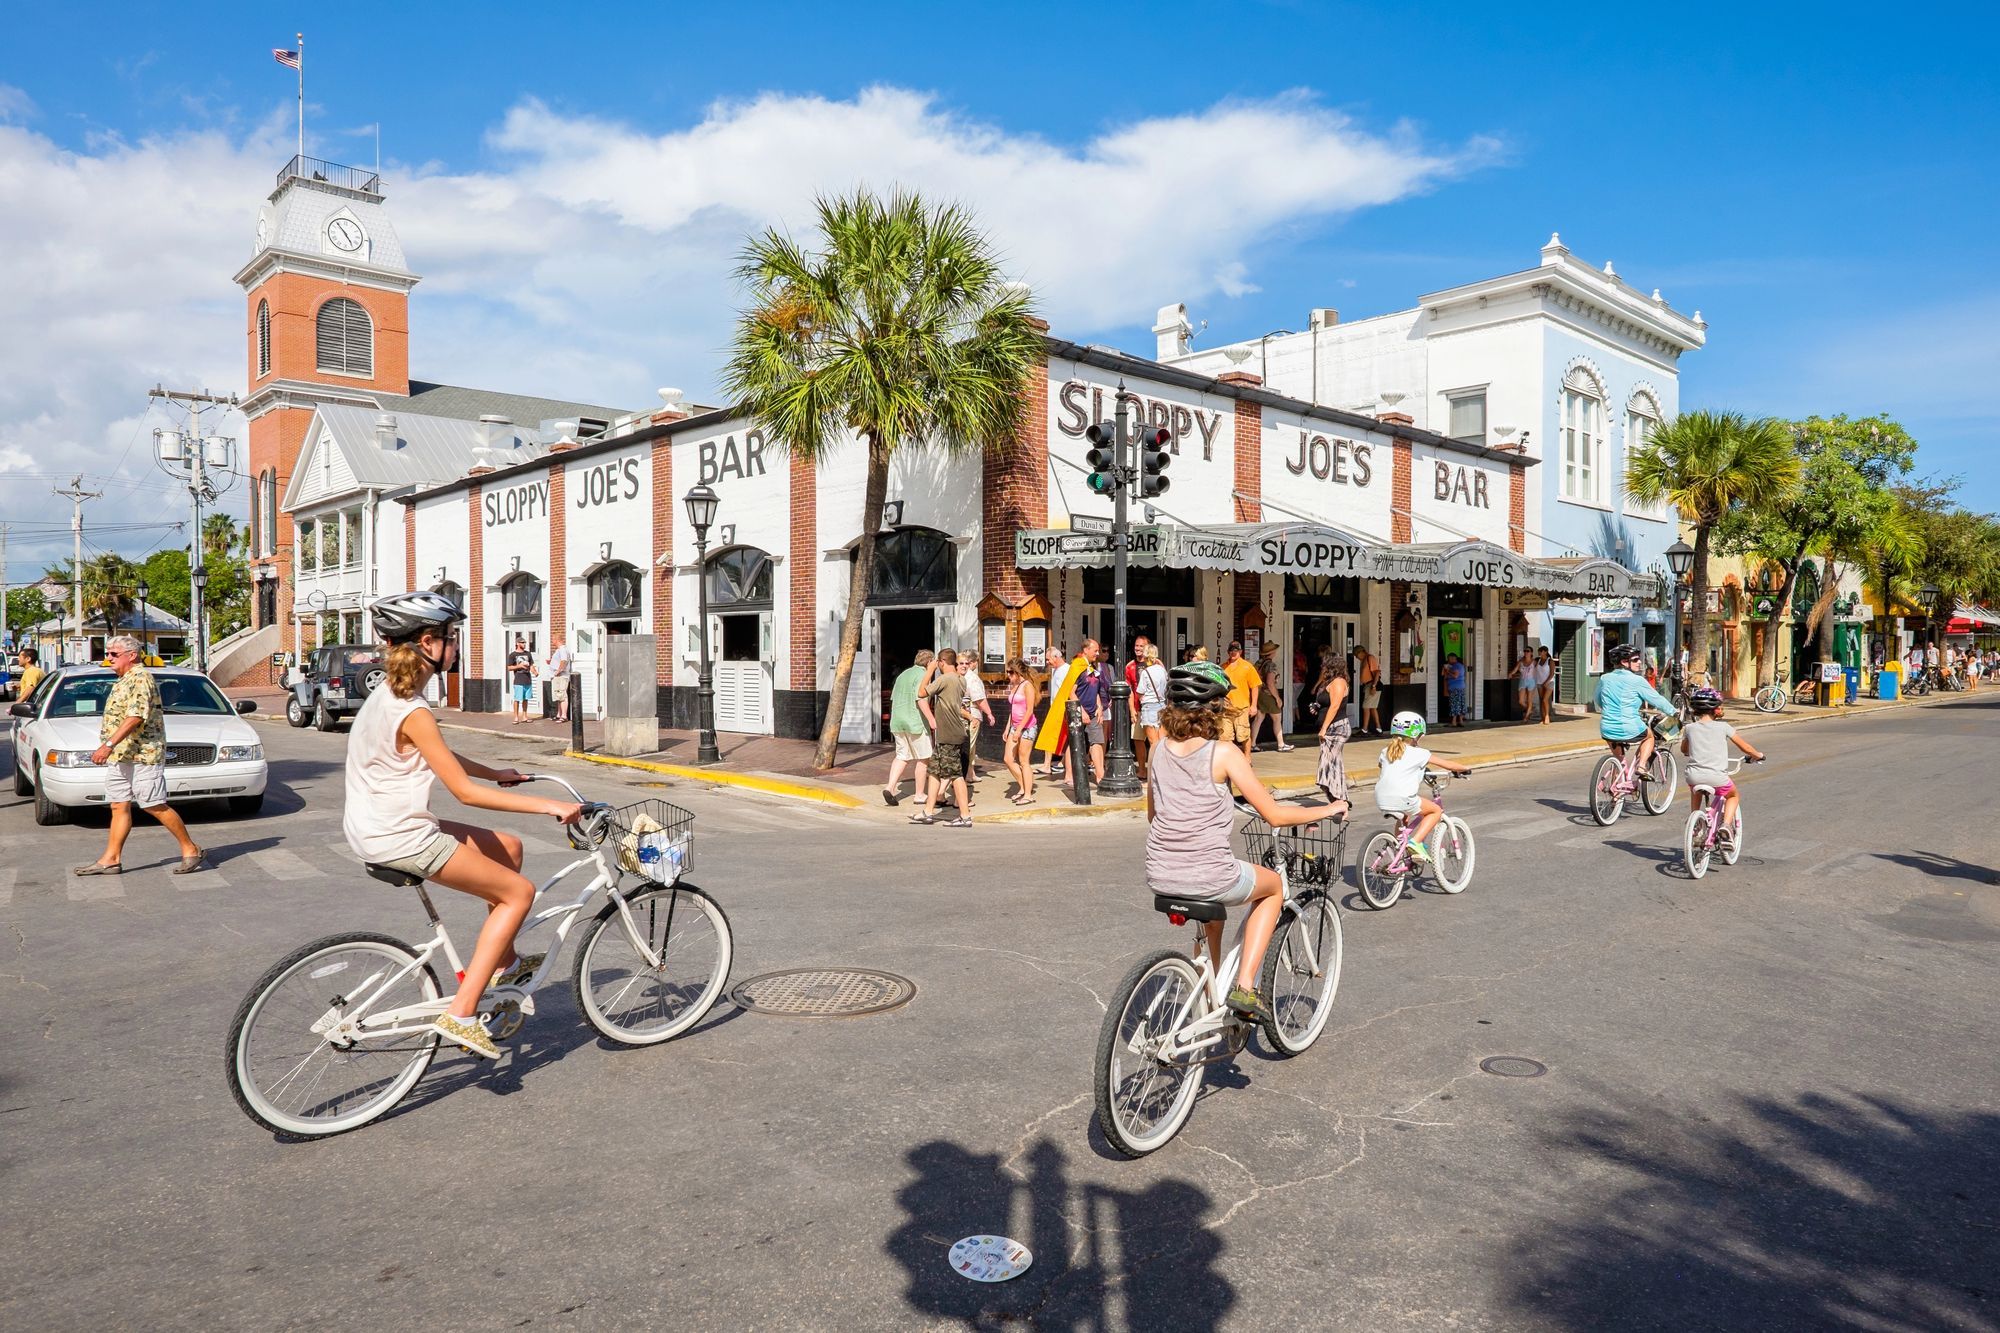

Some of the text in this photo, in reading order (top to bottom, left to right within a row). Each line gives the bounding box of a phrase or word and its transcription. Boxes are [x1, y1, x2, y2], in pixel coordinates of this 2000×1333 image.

[1057, 381, 1490, 509] SLOPPY JOE'S BAR
[485, 429, 767, 528] SLOPPY JOE'S BAR
[1081, 520, 1105, 530] Duval St
[1093, 538, 1100, 546] St
[1022, 534, 1158, 555] SLOPP BAR
[1190, 539, 1244, 561] Cocktails
[1261, 540, 1360, 570] SLOPPY
[1375, 554, 1394, 572] PINA
[1399, 555, 1439, 575] COLADA'S
[1463, 559, 1513, 584] JOE'S
[1588, 573, 1615, 593] BAR
